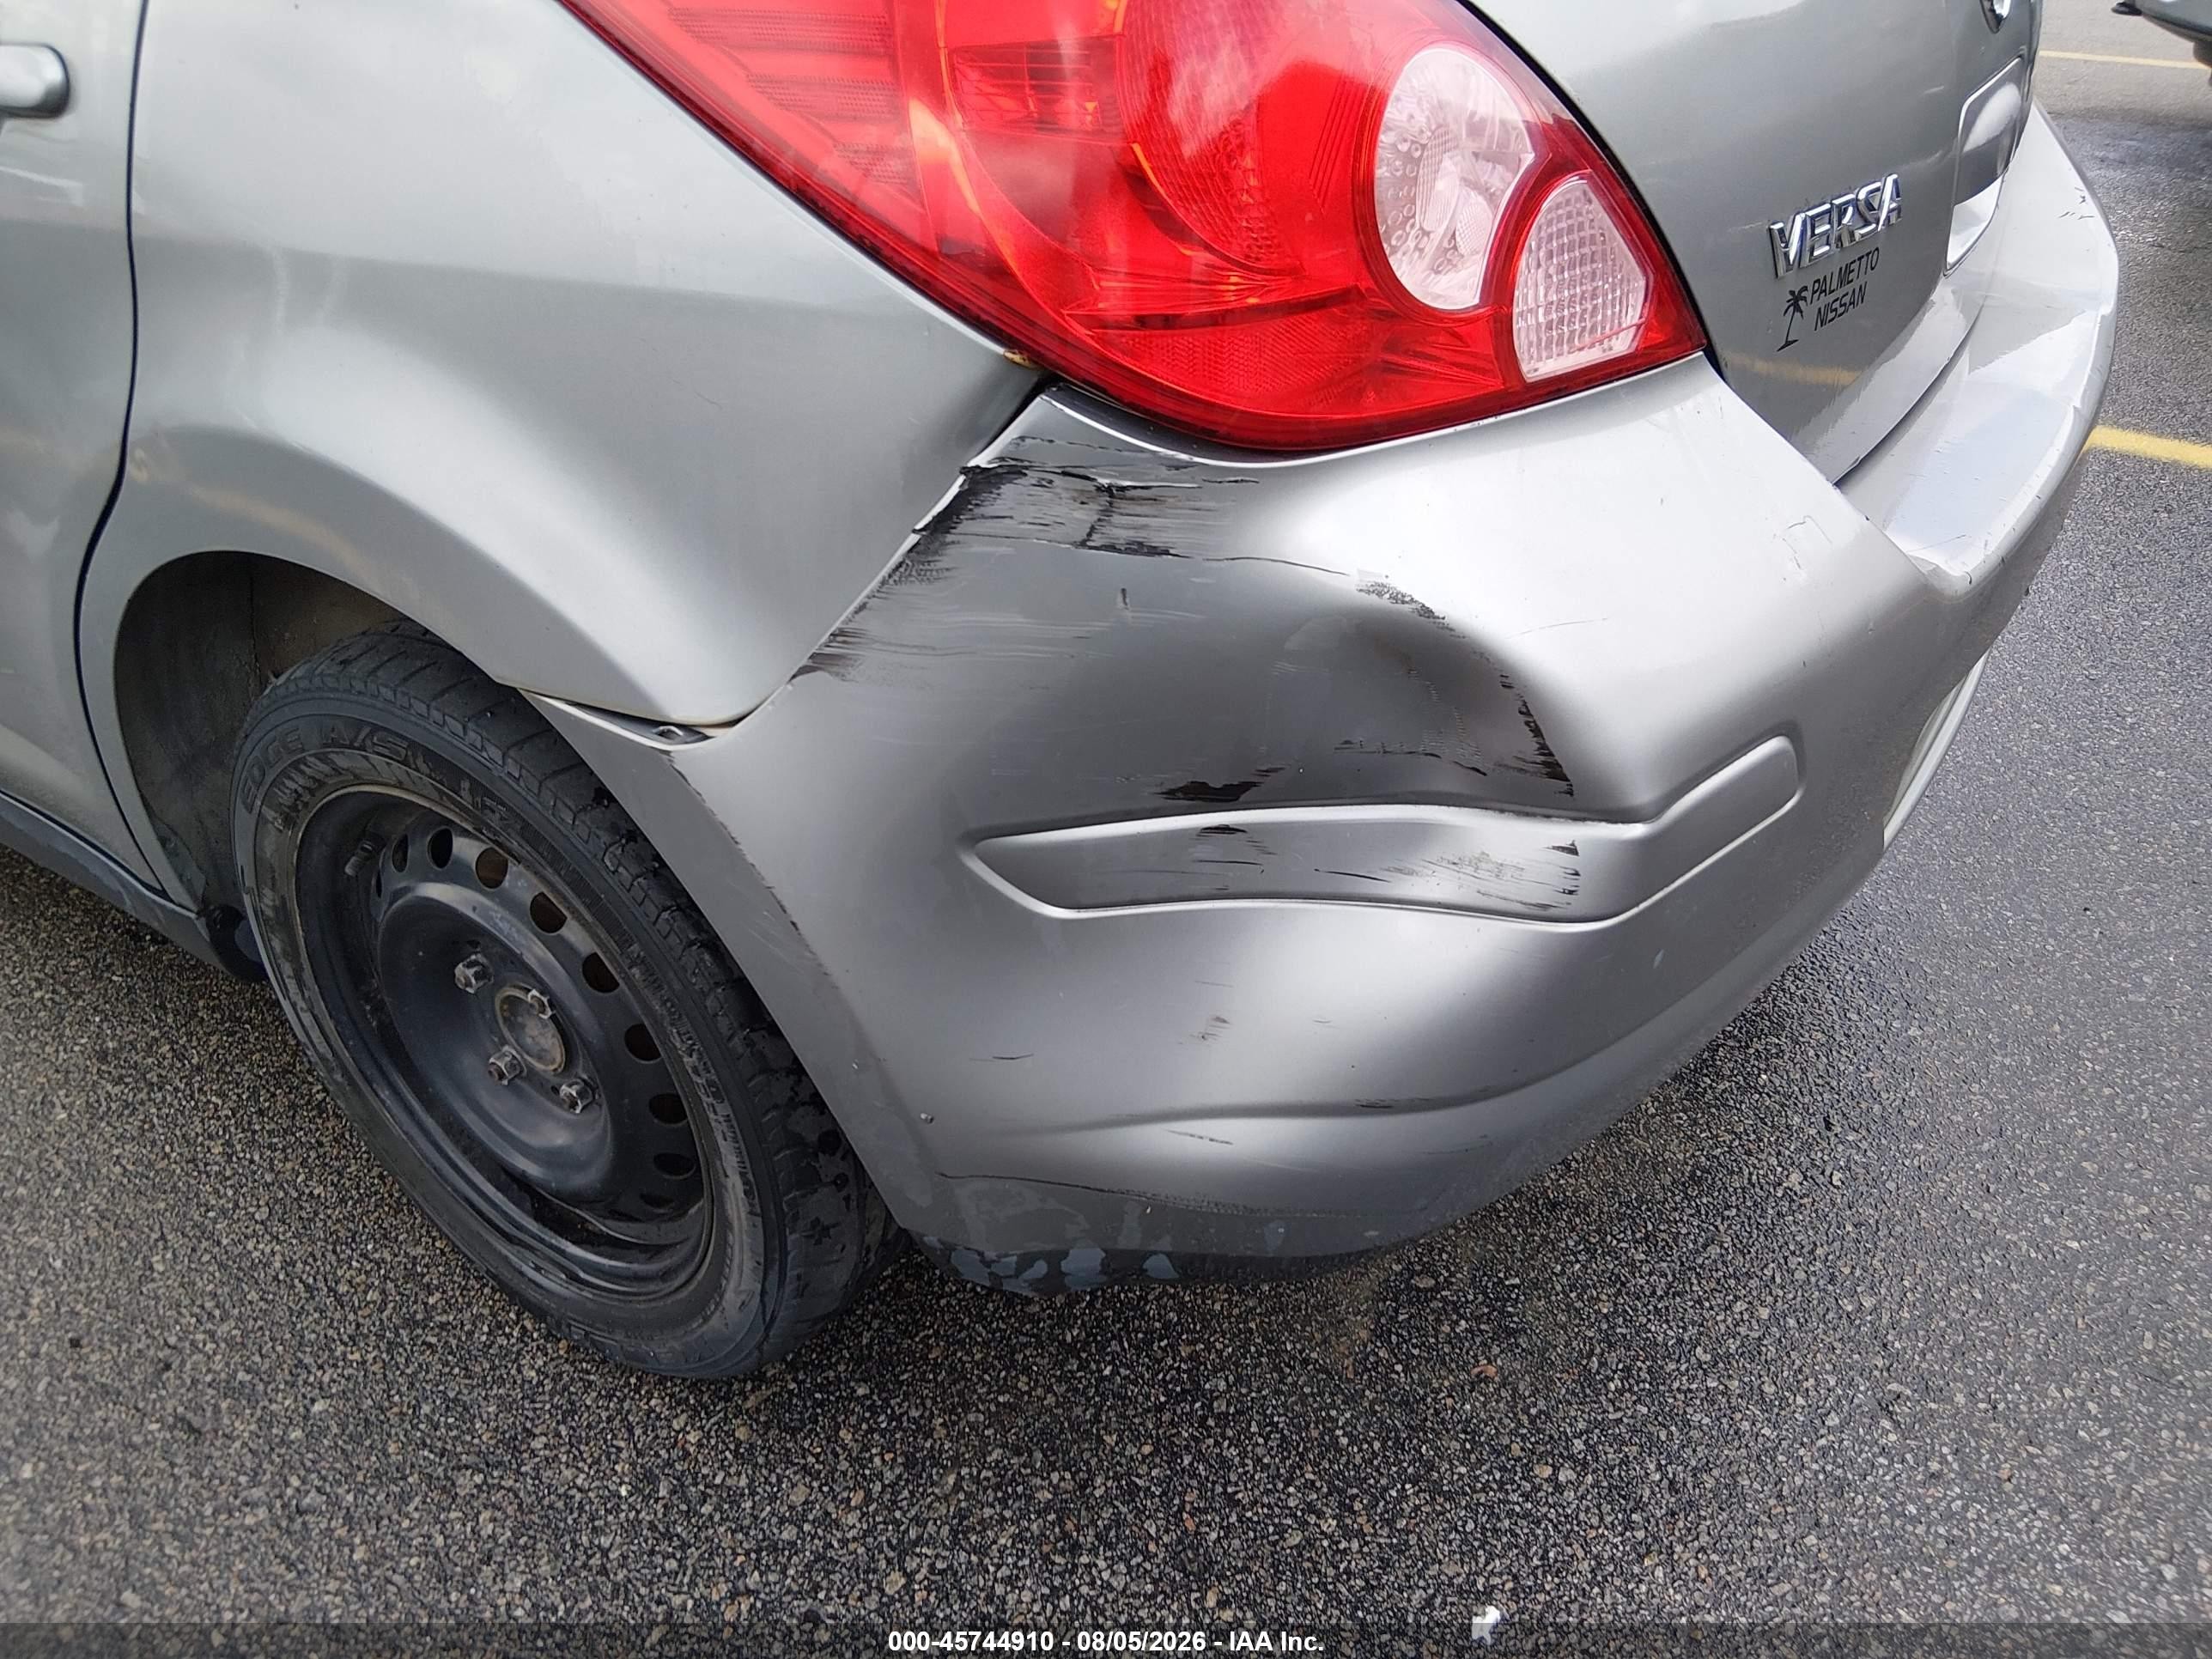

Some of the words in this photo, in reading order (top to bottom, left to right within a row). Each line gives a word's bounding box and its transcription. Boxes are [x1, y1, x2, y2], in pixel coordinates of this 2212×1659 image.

[1769, 173, 1903, 279] VERSA
[1809, 247, 1881, 304] PALMETTO
[1814, 281, 1869, 331] NISSAN
[240, 726, 306, 815] EDGE
